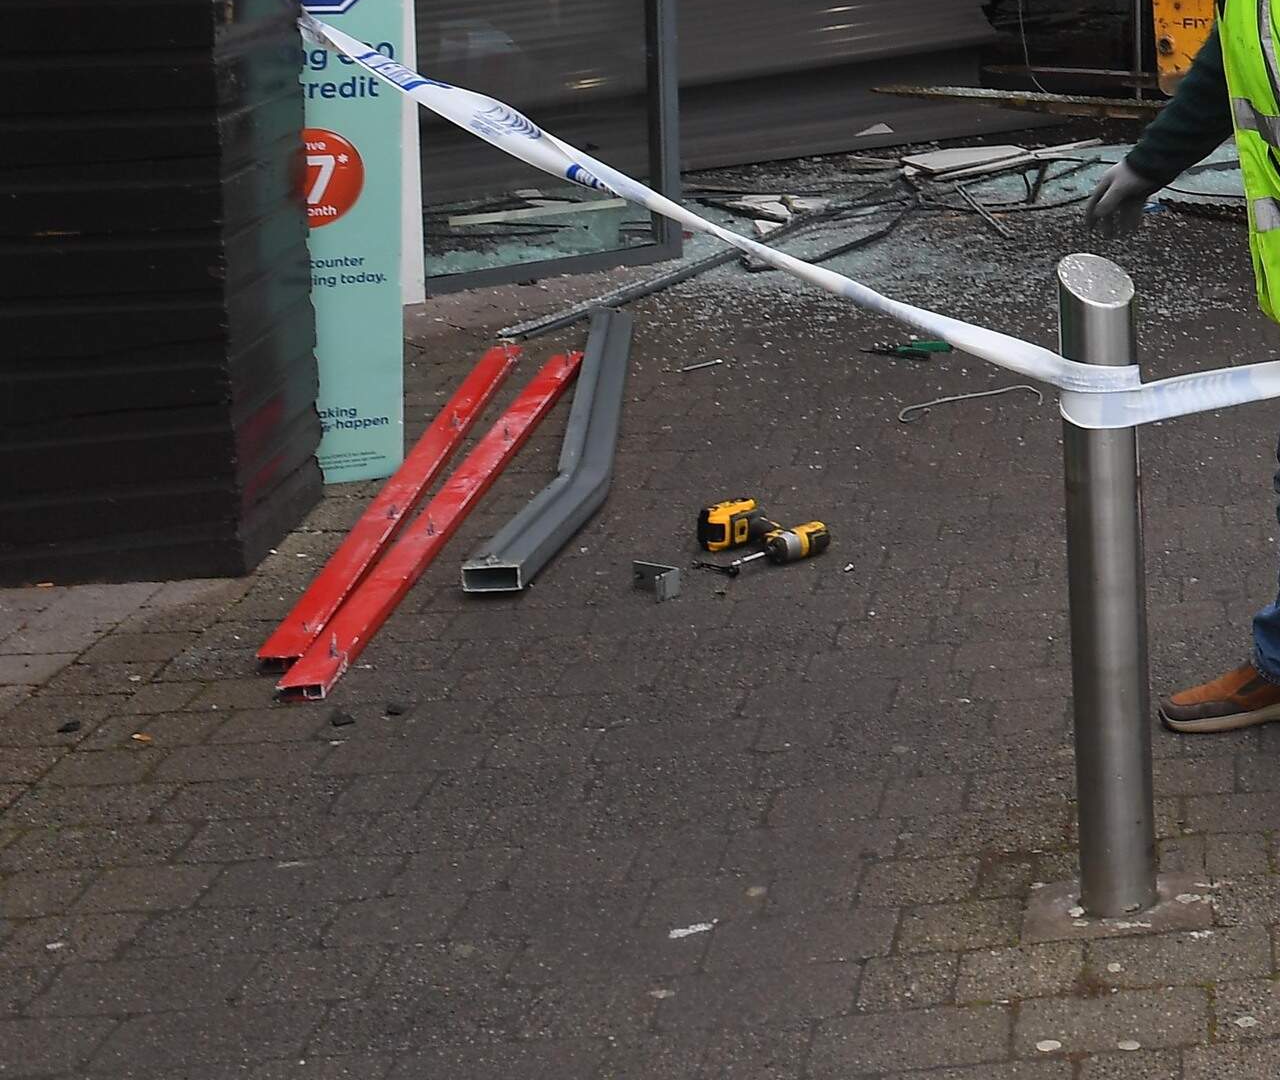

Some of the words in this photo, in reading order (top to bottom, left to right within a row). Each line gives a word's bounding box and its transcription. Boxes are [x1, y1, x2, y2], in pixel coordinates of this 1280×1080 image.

[308, 205, 337, 217] onth
[311, 274, 337, 288] ing
[340, 271, 388, 285] today.
[319, 406, 357, 419] aking
[335, 416, 390, 430] happen
